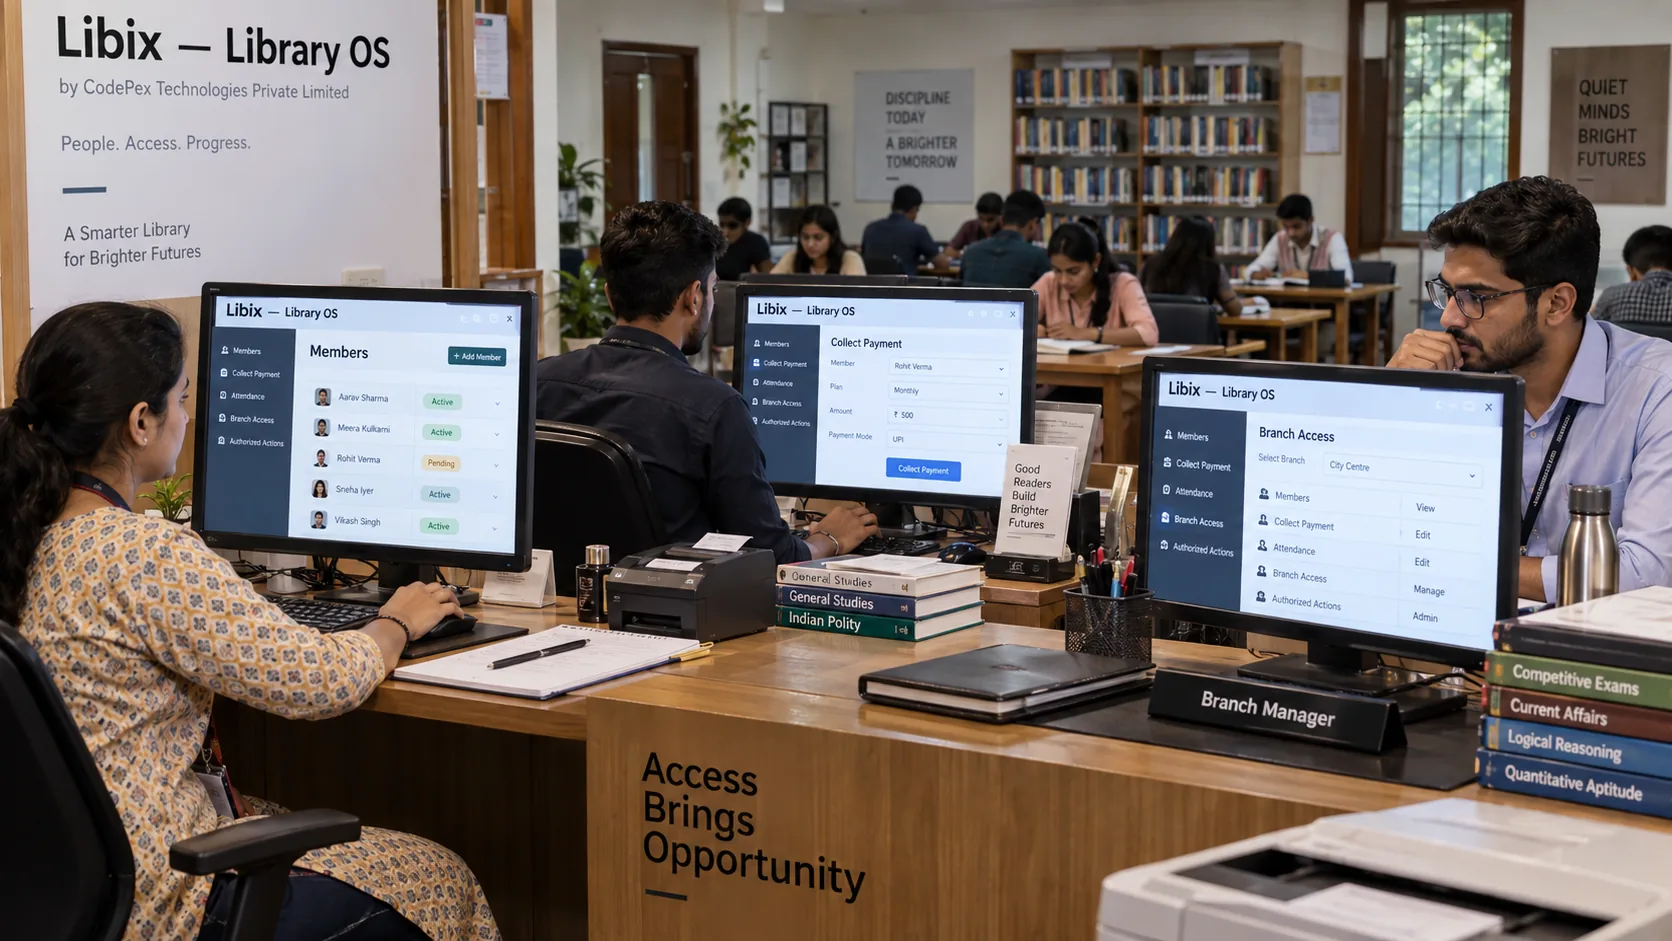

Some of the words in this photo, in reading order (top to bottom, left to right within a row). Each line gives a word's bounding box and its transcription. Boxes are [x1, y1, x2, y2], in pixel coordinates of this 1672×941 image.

[57, 15, 163, 62] Libix
[226, 27, 340, 75] Library
[349, 36, 390, 69] OS
[59, 78, 78, 97] by
[83, 79, 151, 97] CodePex
[156, 81, 248, 101] Technologies
[252, 83, 297, 99] Private
[303, 84, 349, 100] Limited
[1579, 79, 1628, 97] QUIET
[886, 91, 951, 105] DISCIPLINE
[886, 111, 925, 124] TODAY
[1579, 104, 1630, 120] MINDS
[1578, 128, 1637, 144] BRIGHT
[61, 136, 119, 154] People.
[125, 136, 181, 151] Access.
[187, 136, 251, 154] Progress.
[886, 137, 894, 149] A
[898, 136, 957, 150] BRIGHTER
[886, 155, 957, 168] TOMORROW
[1577, 152, 1646, 167] FUTURES
[64, 227, 75, 241] A
[80, 223, 138, 241] Smarter
[143, 222, 191, 241] Library
[64, 249, 85, 267] for
[90, 246, 147, 267] Brighter
[151, 244, 201, 262] Futures
[227, 304, 262, 318] Libix
[285, 307, 320, 319] Library
[323, 308, 338, 319] OS
[757, 303, 787, 316] Libix
[807, 306, 839, 318] Library
[842, 307, 855, 316] OS
[764, 340, 790, 348] Members
[831, 338, 861, 348] Collect
[864, 339, 902, 350] Payment
[233, 347, 261, 355] Members
[310, 345, 368, 359] Members
[475, 354, 501, 362] Member
[784, 360, 807, 368] Payment
[830, 359, 855, 367] Member
[232, 370, 252, 378] Collect
[253, 370, 280, 380] Payment
[1169, 381, 1200, 396] Libix
[1222, 386, 1258, 401] Library
[1261, 388, 1275, 400] OS
[338, 393, 359, 401] Aarav
[361, 394, 389, 403] Sharma
[432, 398, 453, 406] Active
[762, 398, 782, 407] Branch
[829, 407, 852, 415] Amount
[902, 411, 913, 419] 500
[230, 415, 251, 424] Branch
[252, 416, 274, 424] Access
[791, 419, 810, 427] Actions
[338, 424, 359, 433] Meera
[431, 428, 453, 437] Active
[1259, 427, 1295, 440] Branch
[1298, 429, 1334, 442] Access
[829, 431, 854, 441] Payment
[856, 432, 873, 440] Mode
[1177, 431, 1209, 442] Members
[263, 439, 284, 447] Actions
[337, 454, 356, 463] Rohit
[358, 455, 380, 464] Verma
[428, 459, 455, 469] Pending
[1259, 453, 1279, 463] Select
[1281, 455, 1305, 465] Branch
[898, 464, 919, 473] Collect
[922, 465, 949, 476] Payment
[1015, 463, 1040, 474] Good
[1176, 459, 1200, 469] Collect
[1202, 461, 1231, 472] Payment
[1330, 460, 1344, 472] City
[1346, 462, 1369, 472] Centre
[1014, 477, 1051, 489] Readers
[336, 486, 358, 494] Sneha
[361, 487, 374, 496] Iyer
[429, 490, 451, 499] Active
[1012, 491, 1036, 501] Build
[1275, 492, 1310, 503] Members
[1011, 504, 1048, 516] Brighter
[1416, 503, 1435, 513] View
[360, 517, 381, 527] Singh
[428, 522, 450, 530] Active
[1009, 518, 1044, 529] Futures
[1174, 515, 1198, 526] Branch
[1199, 517, 1223, 528] Access
[1274, 517, 1299, 528] Collect
[1302, 519, 1334, 531] Payment
[1416, 530, 1431, 540] Edit
[1209, 545, 1234, 557] Actions
[1273, 543, 1316, 556] Attendance
[1415, 557, 1430, 567] Edit
[1273, 569, 1298, 580] Branch
[1300, 571, 1327, 583] Access
[1414, 585, 1445, 597] Manage
[790, 590, 830, 605] General
[834, 594, 874, 610] Studies
[1272, 594, 1312, 607] Authorized
[1313, 599, 1341, 610] Actions
[789, 612, 824, 626] Indian
[828, 616, 861, 633] Polity
[1413, 612, 1438, 623] Admin
[1513, 664, 1592, 693] Competitive
[1595, 675, 1640, 696] Exams
[1201, 691, 1257, 716] Branch
[1262, 701, 1335, 728] Manager
[1510, 699, 1560, 720] Current
[1563, 706, 1608, 726] Affairs
[1508, 729, 1553, 750] Logical
[1556, 737, 1622, 763] Reasoning
[642, 752, 758, 796] Access
[1505, 765, 1583, 792] Quantitative
[1586, 777, 1643, 801] Aptitude
[644, 791, 754, 841] Brings
[644, 830, 866, 904] Opportunity
